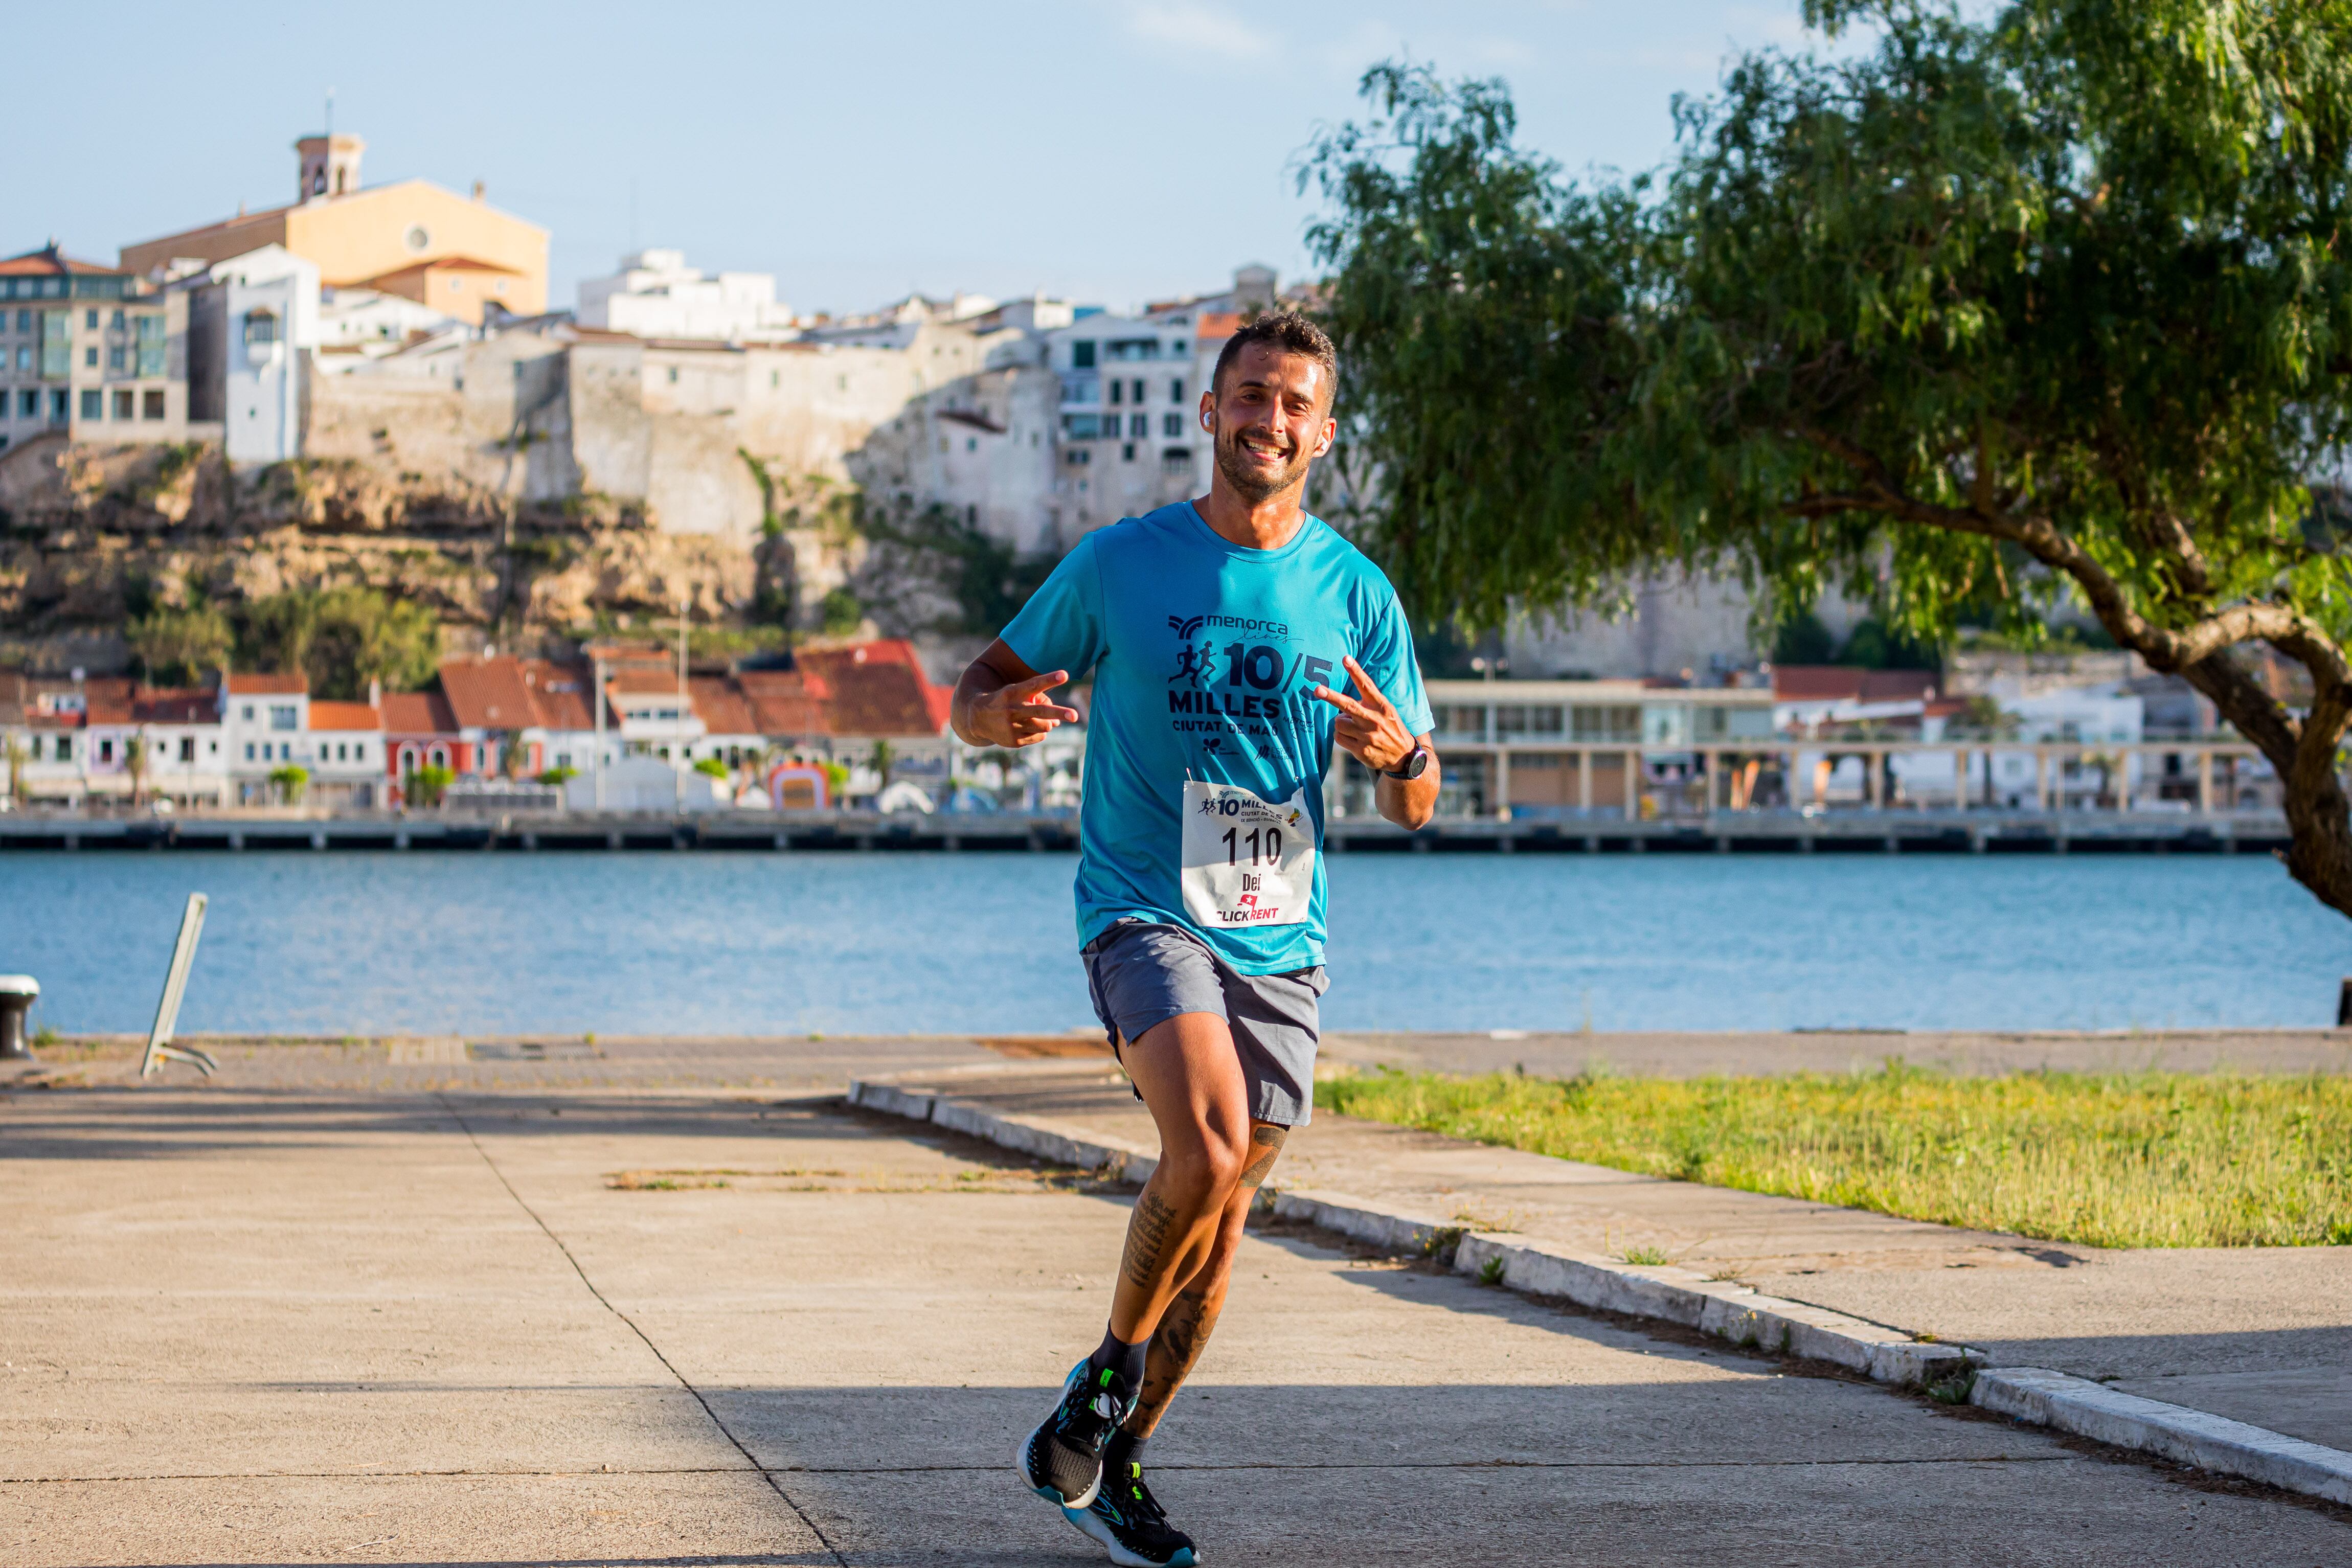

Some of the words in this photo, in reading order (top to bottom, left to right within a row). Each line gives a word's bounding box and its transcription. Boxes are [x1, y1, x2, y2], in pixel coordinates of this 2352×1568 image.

[1207, 615, 1288, 635] menorca
[1227, 623, 1304, 644] lines
[1224, 643, 1332, 701] 10/5
[1169, 690, 1280, 719] MILLES
[1173, 720, 1222, 732] CIUTAT
[1228, 723, 1243, 734] DE
[1217, 799, 1239, 816] 10
[1223, 827, 1282, 866] 110
[1242, 873, 1261, 891] Dei
